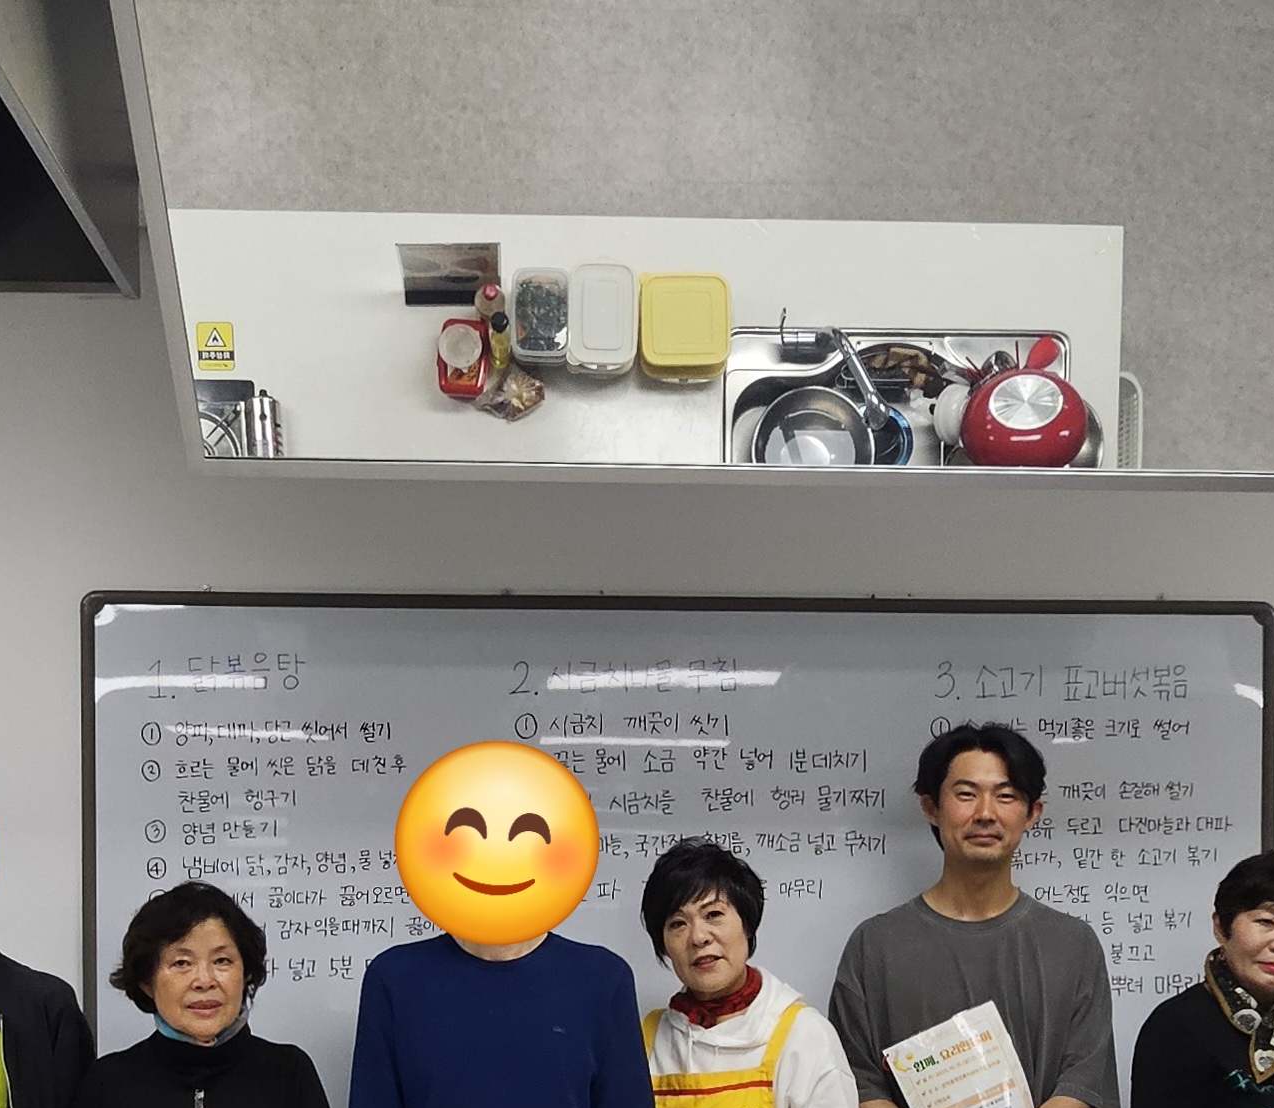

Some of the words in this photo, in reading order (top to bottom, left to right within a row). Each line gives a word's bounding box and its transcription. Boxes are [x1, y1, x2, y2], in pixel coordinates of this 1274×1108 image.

[188, 652, 306, 692] 닭볶음탕
[976, 664, 1043, 699] 소고기
[1063, 664, 1188, 701] 표고버섯볶음
[302, 720, 348, 743] 씻어서
[359, 721, 391, 741] 썰기
[549, 712, 603, 738] 시금치
[623, 711, 679, 735] 깨끗이
[689, 713, 729, 736] 씻기
[1105, 719, 1142, 739] 크기로
[1153, 718, 1190, 739] 썰어
[175, 759, 215, 780] 흐르는
[227, 756, 258, 777] 물에
[267, 756, 295, 777] 씻은
[307, 755, 337, 777] 닭을
[595, 748, 626, 774] 물에
[643, 750, 677, 773] 소금
[693, 747, 728, 771] 약간
[740, 747, 773, 771] 넣어
[178, 790, 229, 813] 찬물에
[609, 790, 676, 815] 시금치를
[701, 787, 754, 812] 찬물에
[1059, 782, 1106, 801] 깨끗이
[182, 821, 216, 845] 양념
[223, 819, 278, 840] 만들기
[1067, 817, 1104, 836] 두르고
[845, 830, 886, 857] 무치기
[1138, 848, 1177, 867] 소고기
[1187, 845, 1218, 867] 볶기
[182, 855, 239, 880] 냄비에
[268, 886, 327, 908] 끓이다가
[780, 878, 823, 899] 마무리
[1104, 882, 1150, 903] 익으면
[1128, 911, 1154, 934] 넣고
[1164, 908, 1193, 930] 볶기
[289, 958, 316, 982] 넣고
[329, 955, 354, 980] 5분
